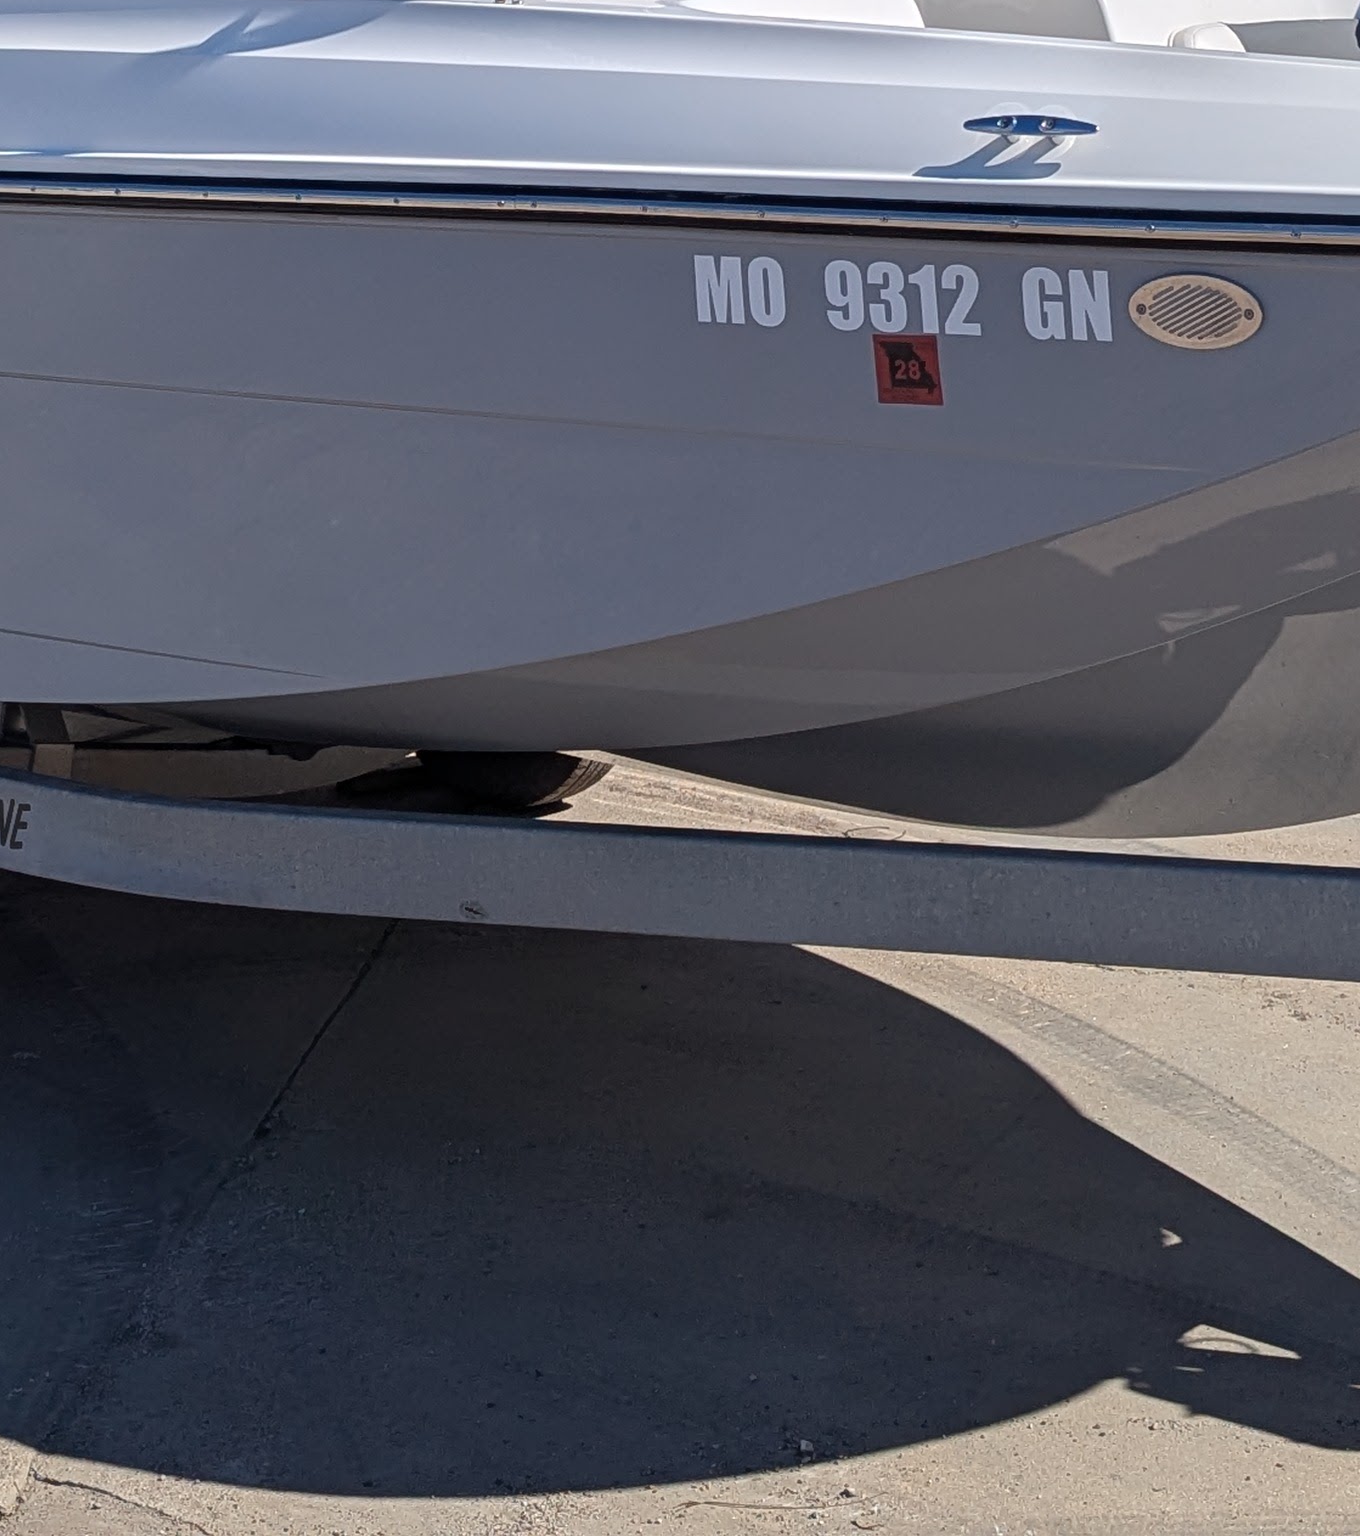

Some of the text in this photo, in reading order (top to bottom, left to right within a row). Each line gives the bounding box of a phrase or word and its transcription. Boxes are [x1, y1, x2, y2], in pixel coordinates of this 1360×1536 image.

[694, 255, 1113, 341] MO 9312 GN
[894, 359, 921, 381] 28
